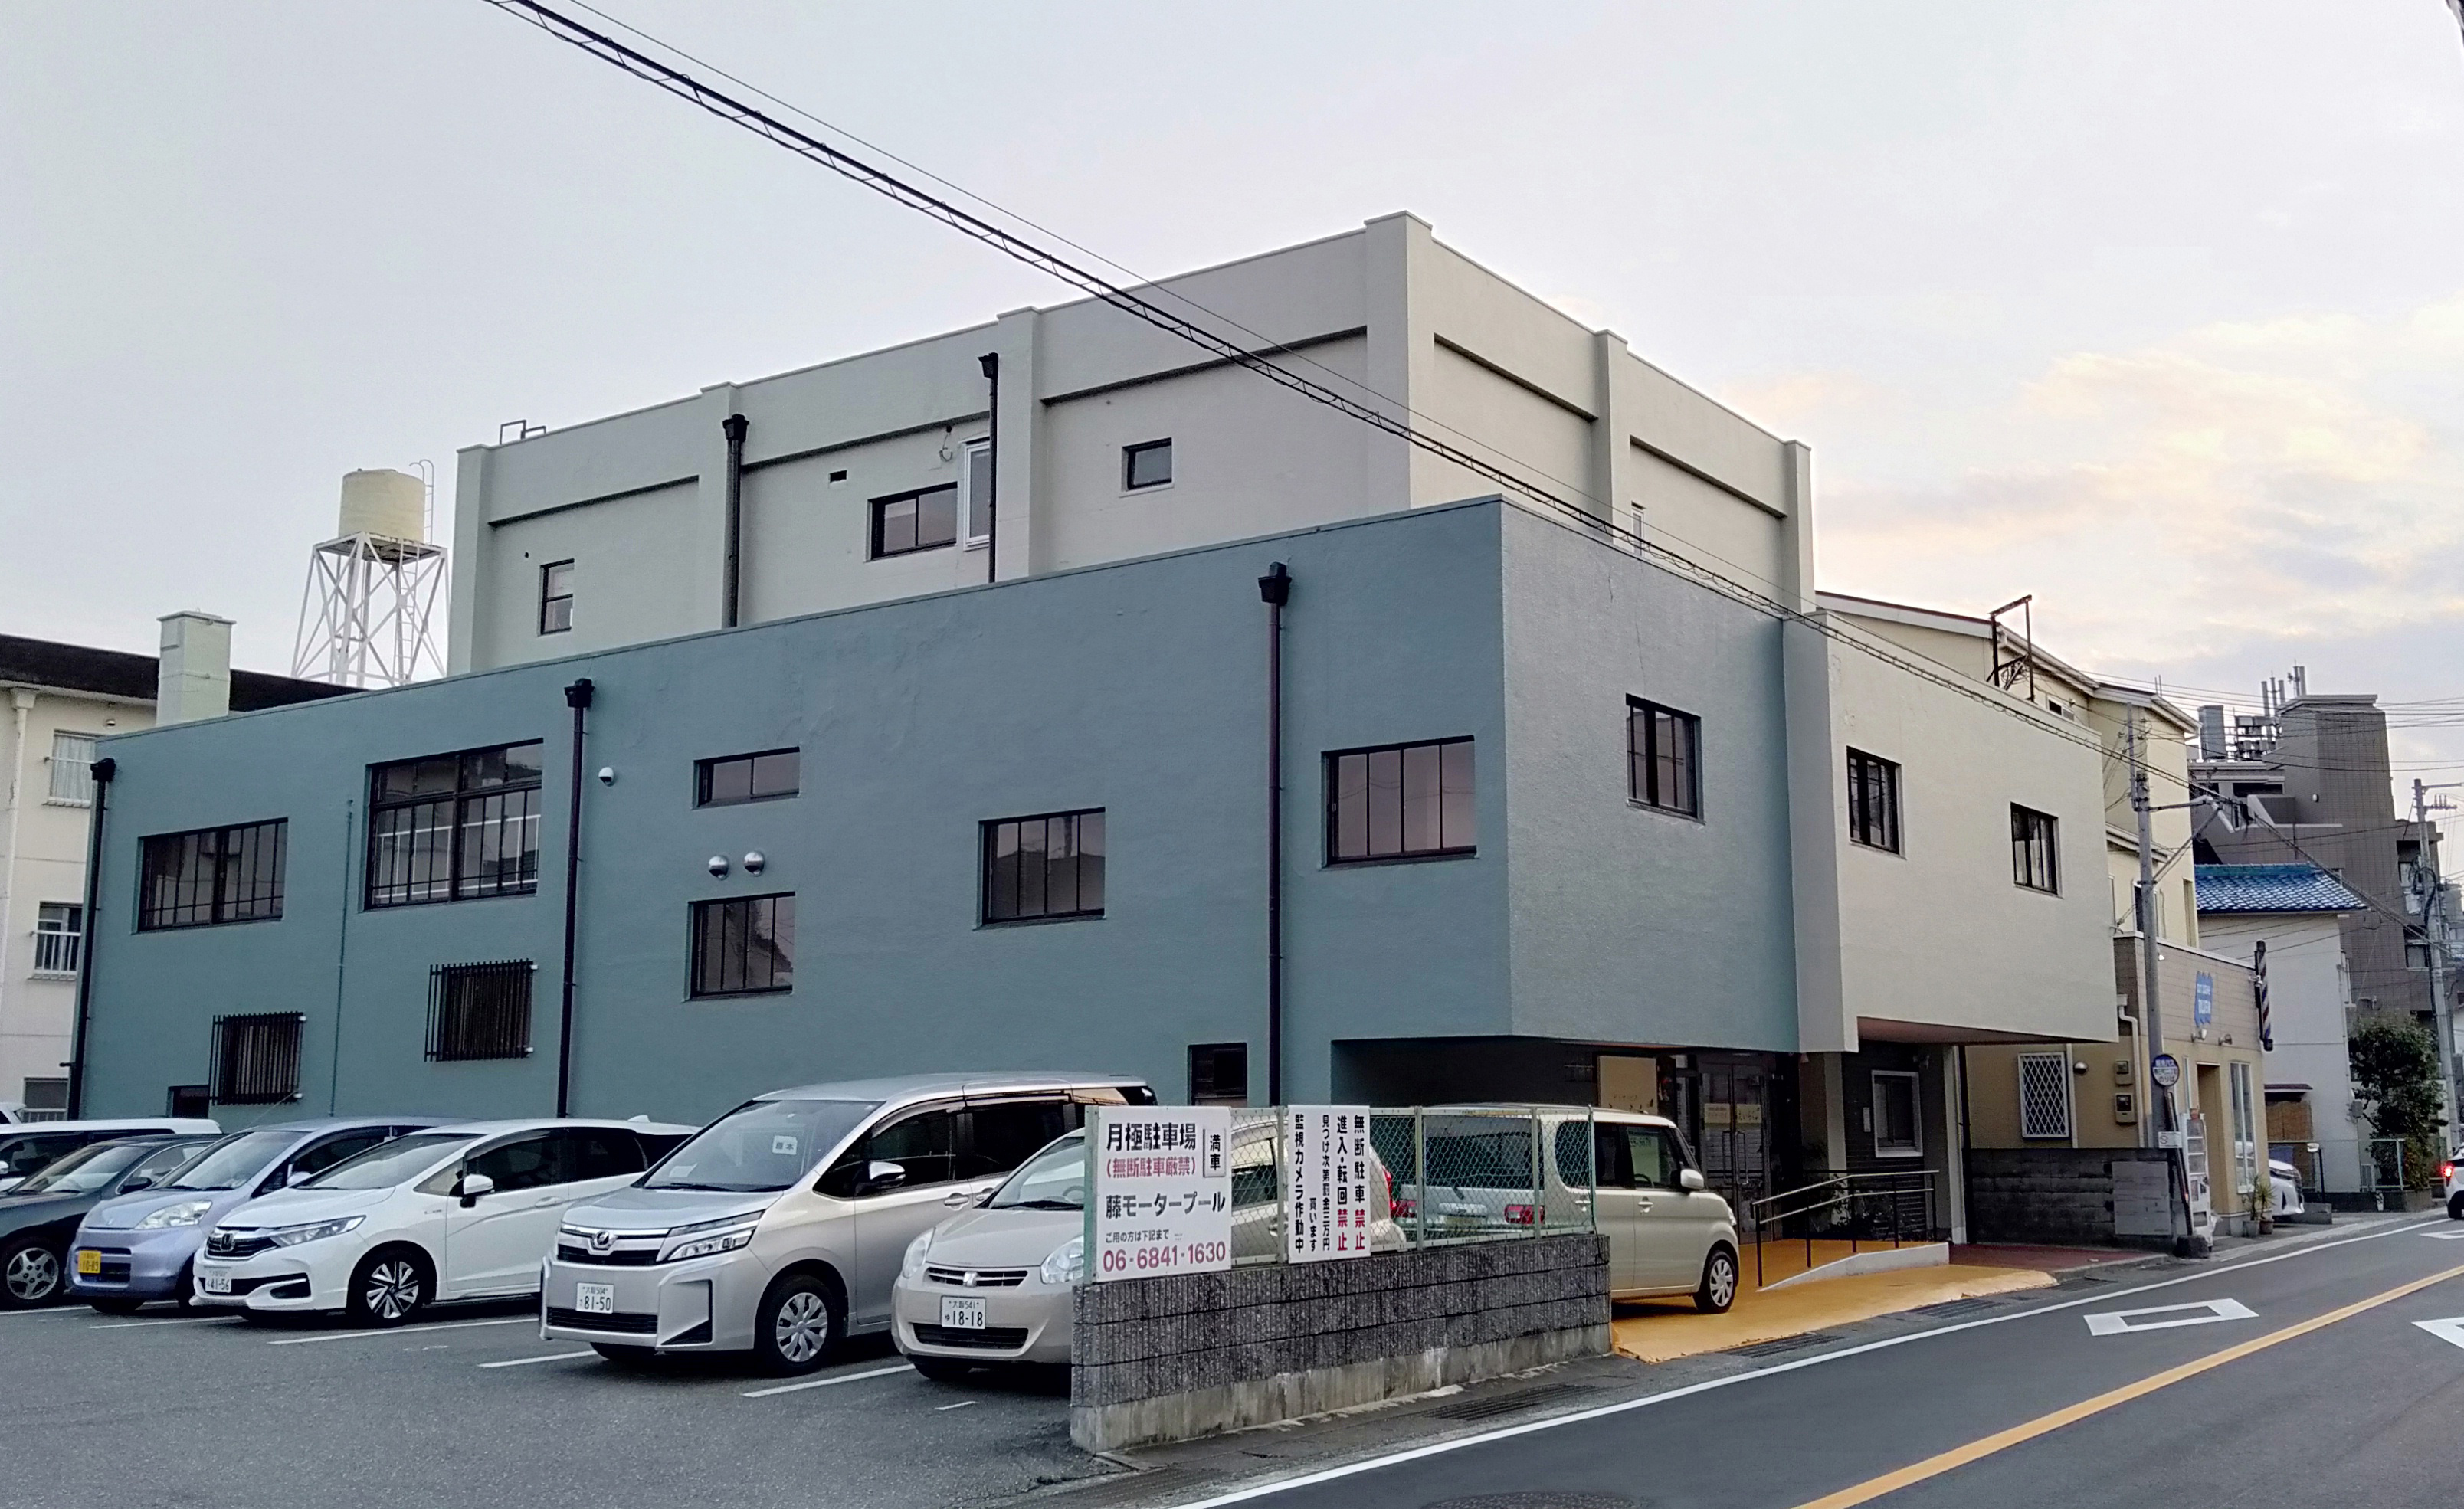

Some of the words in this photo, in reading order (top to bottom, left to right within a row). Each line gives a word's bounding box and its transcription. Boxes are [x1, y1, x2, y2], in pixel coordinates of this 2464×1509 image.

[1106, 1122, 1196, 1151] 月極駐車場
[1209, 1134, 1221, 1171] 満車
[1106, 1156, 1197, 1179] (無断駐車厳禁)
[1294, 1113, 1304, 1254] 監視カメラ作動中
[1336, 1115, 1348, 1252] 進入・転回禁止
[1354, 1115, 1365, 1251] 無断駐車禁止
[1106, 1190, 1226, 1219] 藤モータープール
[1105, 1229, 1170, 1244] ご用の方は下記まで
[585, 1295, 611, 1311] 81-50
[953, 1311, 983, 1327] 18-18
